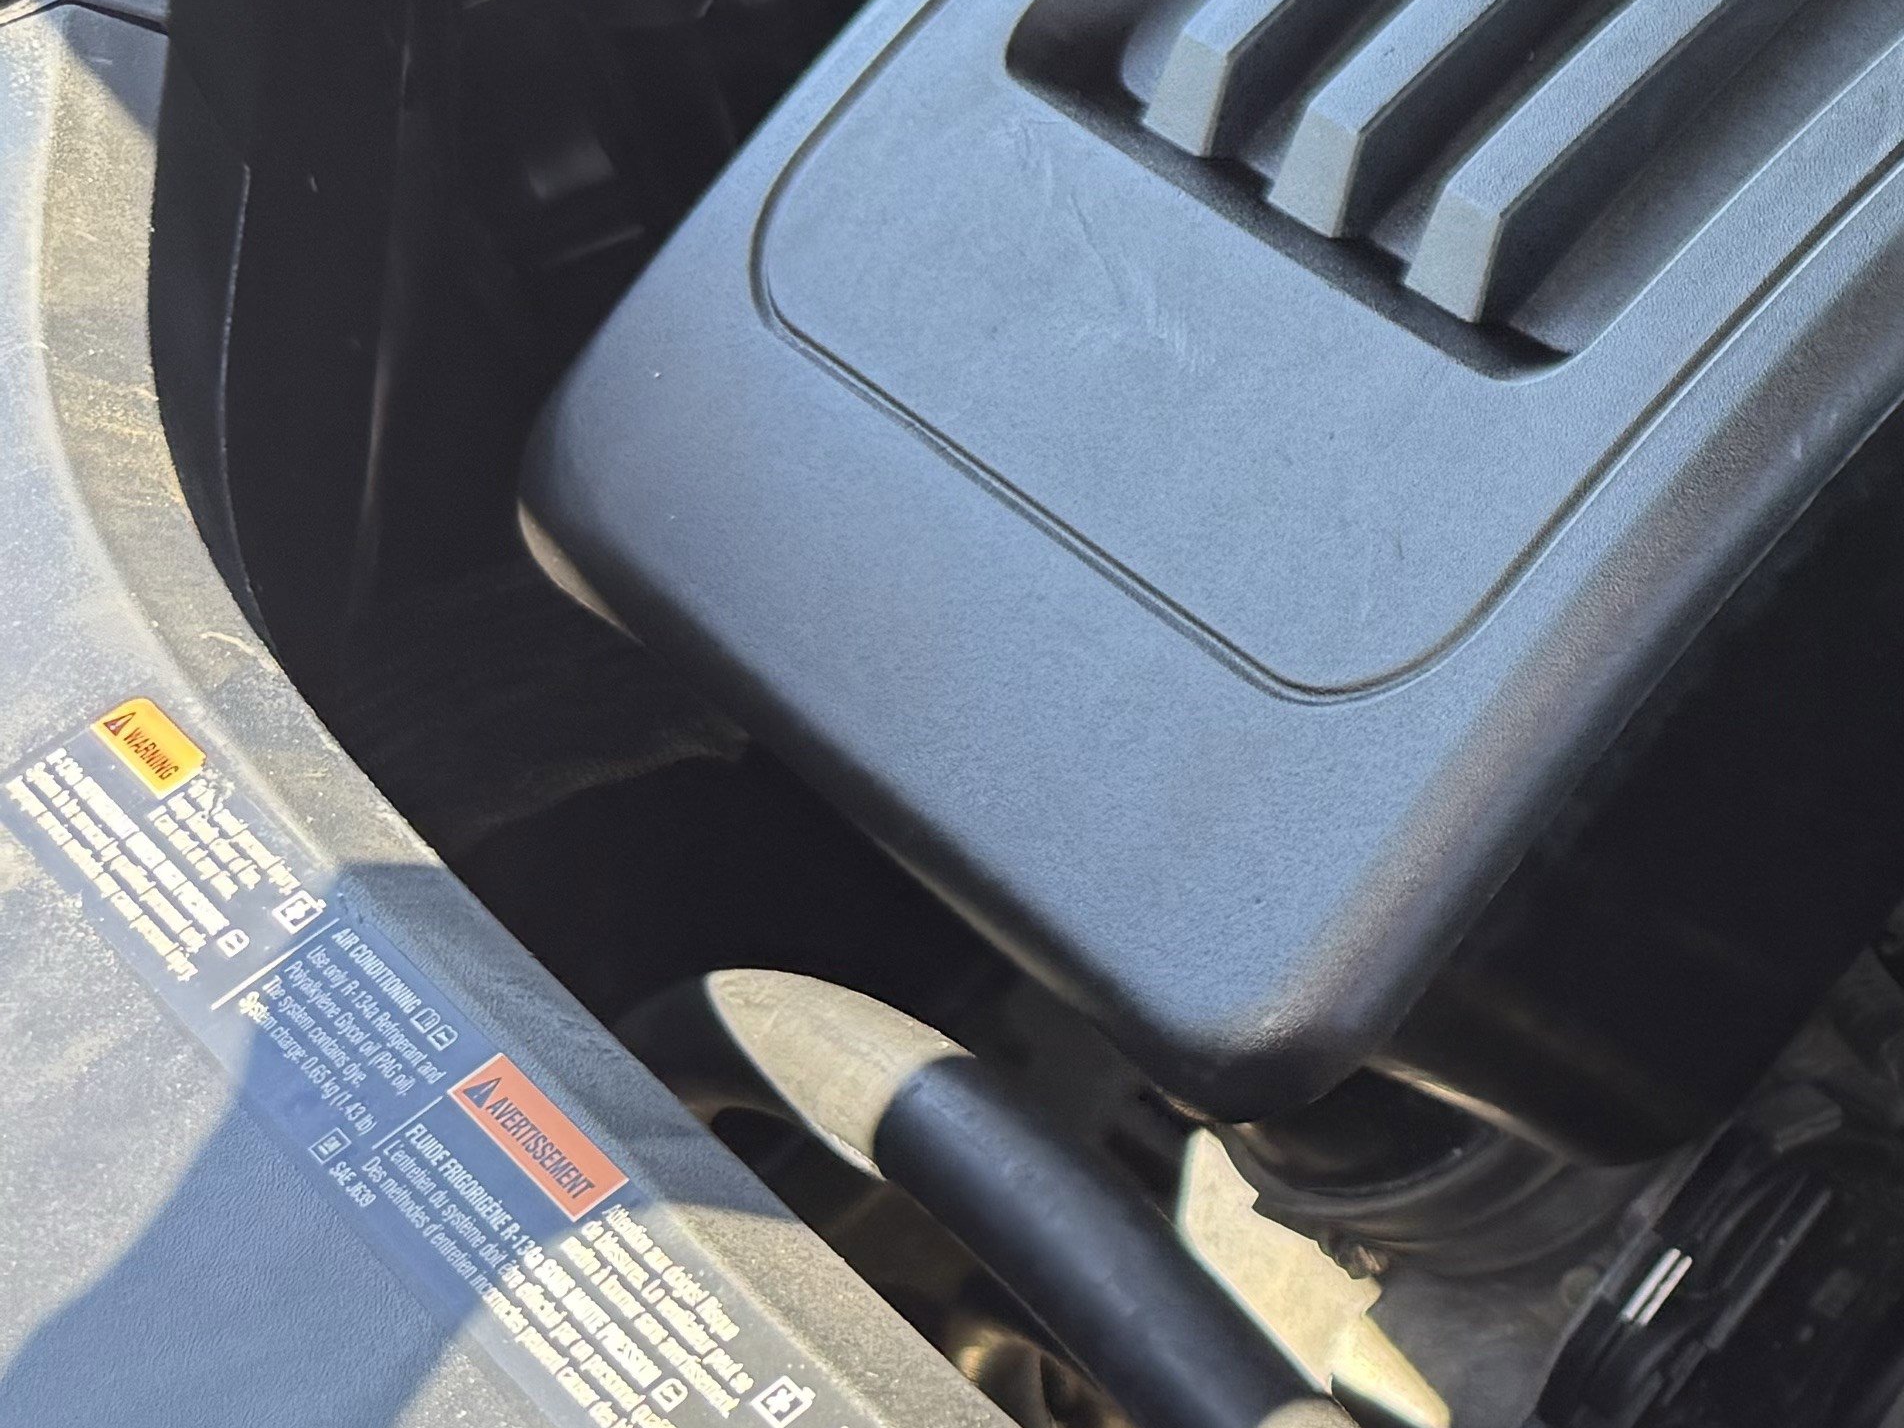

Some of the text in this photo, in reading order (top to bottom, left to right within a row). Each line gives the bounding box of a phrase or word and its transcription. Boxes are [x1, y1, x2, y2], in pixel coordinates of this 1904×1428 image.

[123, 727, 180, 781] WARNING
[261, 974, 367, 1089] The system contains dye.
[283, 960, 416, 1097] Polyalkylene Glycol oil (PAG oil).
[306, 944, 447, 1085] Use only R-134a Refrigerant and
[331, 927, 422, 1014] AIR CONDITIONING
[237, 990, 378, 1137] System charge: 0.65 kg (1.43 lb)
[328, 1161, 377, 1208] SAE J639
[404, 1123, 451, 1167] FLUIDE
[437, 1157, 513, 1232] FRIGORIGÈNE
[499, 1222, 545, 1272] R-134a
[485, 1096, 596, 1199] AVERTISSEMENT
[361, 1155, 388, 1183] Des
[379, 1177, 431, 1229] méthodes
[422, 1223, 478, 1280] d'entretien
[382, 1139, 437, 1196] L'entretien
[428, 1190, 450, 1209] du
[441, 1203, 487, 1249] système
[478, 1242, 509, 1269] doit
[498, 1259, 526, 1290] être
[601, 1203, 654, 1255] Attention
[643, 1246, 674, 1275] aux
[688, 1295, 740, 1342] Risque
